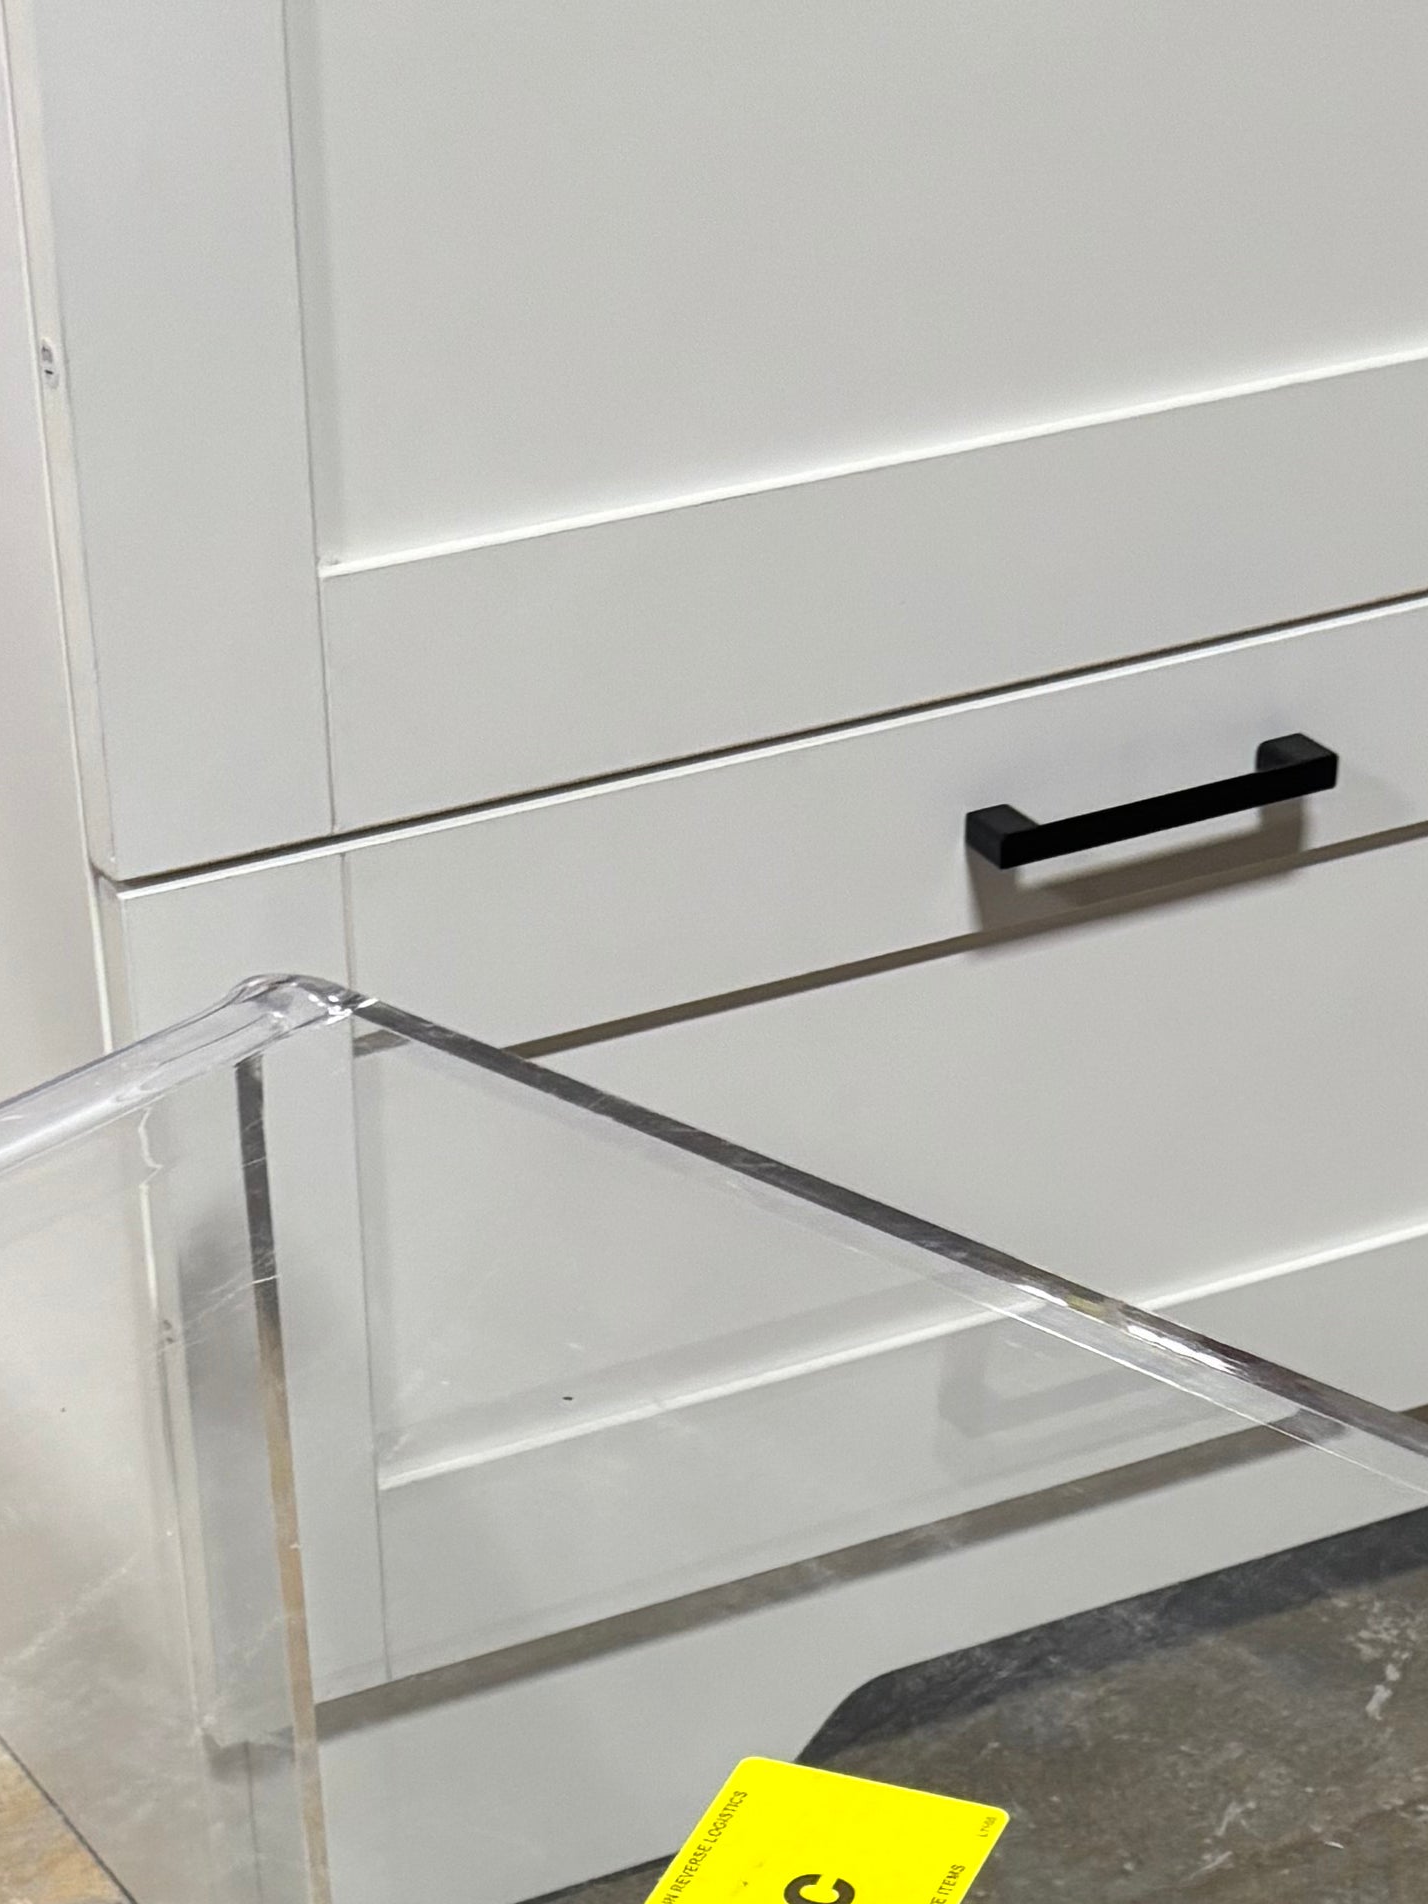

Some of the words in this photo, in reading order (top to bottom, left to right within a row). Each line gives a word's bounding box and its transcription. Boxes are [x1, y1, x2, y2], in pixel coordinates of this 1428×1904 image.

[669, 1843, 713, 1893] REVERSE
[703, 1790, 749, 1843] LOGISTICS
[936, 1863, 967, 1896] ITEMS
